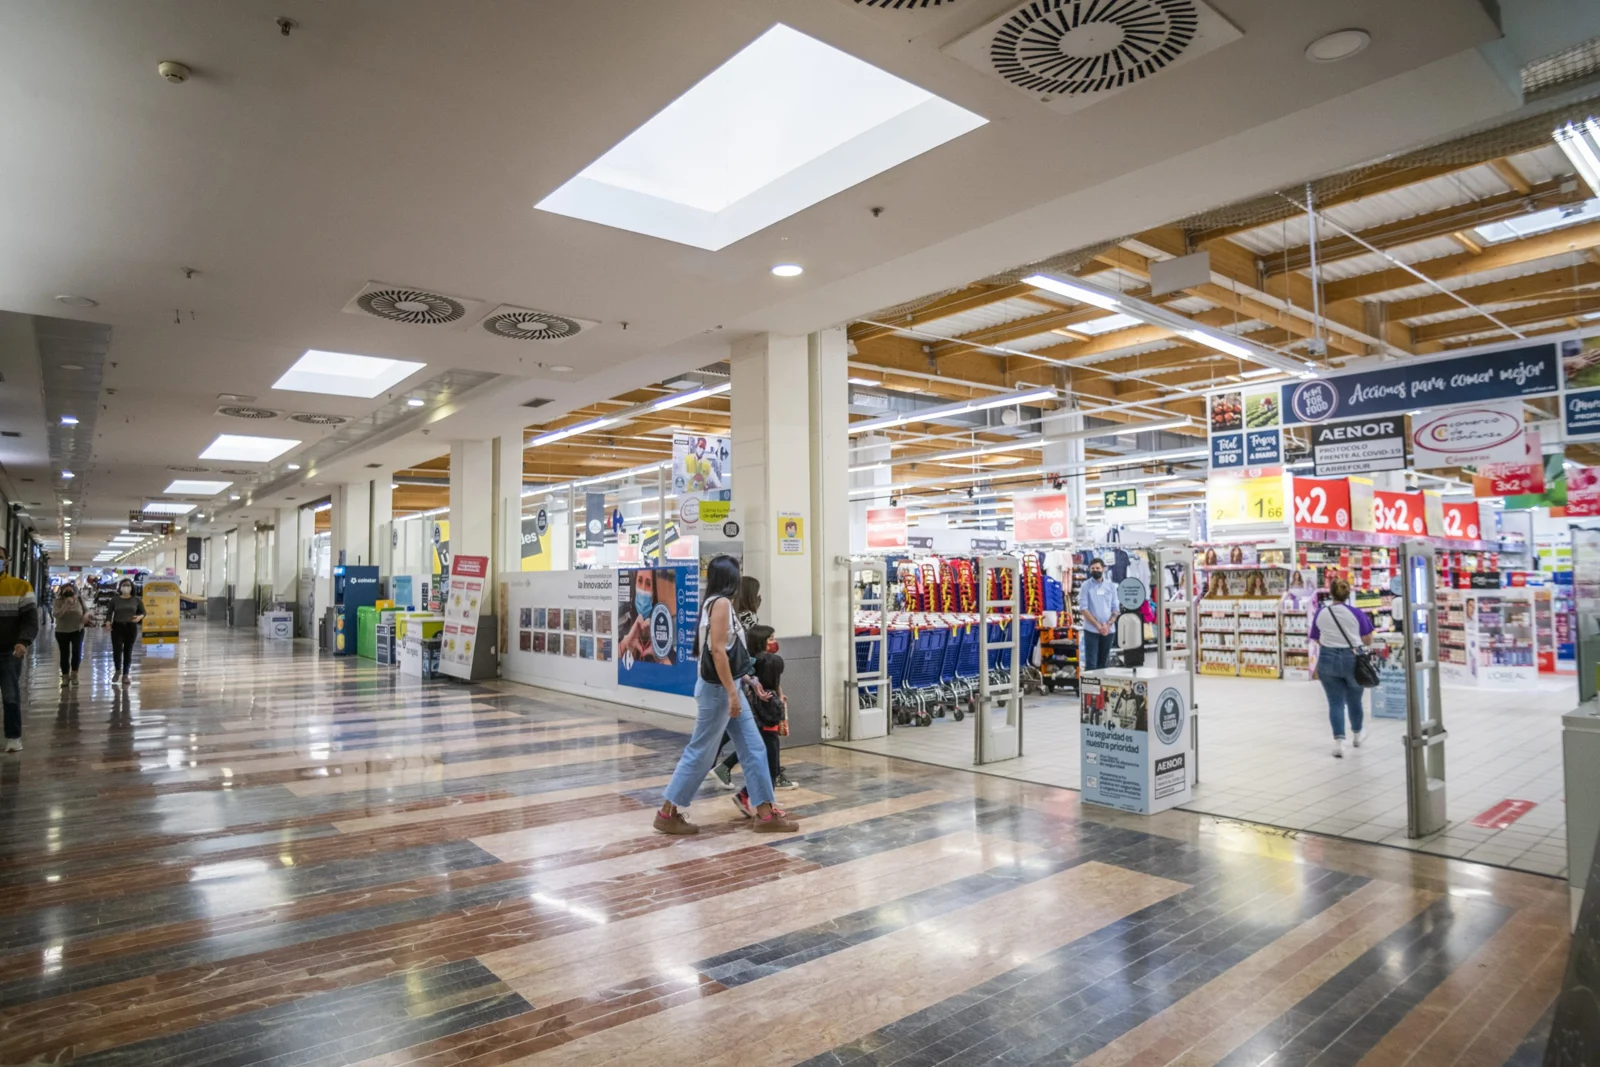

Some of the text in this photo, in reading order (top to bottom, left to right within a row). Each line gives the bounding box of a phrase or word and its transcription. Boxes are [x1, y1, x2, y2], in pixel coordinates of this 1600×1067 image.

[1348, 360, 1544, 405] Acciones para comer mejor
[1306, 394, 1324, 407] FOR
[1306, 402, 1328, 416] FOOD
[1450, 418, 1500, 428] comercio
[1318, 422, 1394, 442] AENOR
[1450, 431, 1502, 442] confianza
[1319, 444, 1368, 454] PROTOCOLO
[1320, 448, 1401, 461] FRENTE AL COVID-19
[1218, 454, 1237, 464] BIO
[1320, 463, 1370, 474] CARREFOUR
[1496, 480, 1520, 492] 3x2
[1254, 498, 1264, 518] 1
[1268, 508, 1282, 518] 66
[1374, 498, 1410, 531] 3x2
[1567, 504, 1588, 514] 3x2
[1016, 508, 1064, 522] Super Precio
[578, 580, 612, 589] la Innovación
[1086, 728, 1094, 737] Tu
[1094, 731, 1125, 742] seguridad
[1086, 740, 1139, 754] nuestra prioridad
[1156, 757, 1183, 772] AENOR
